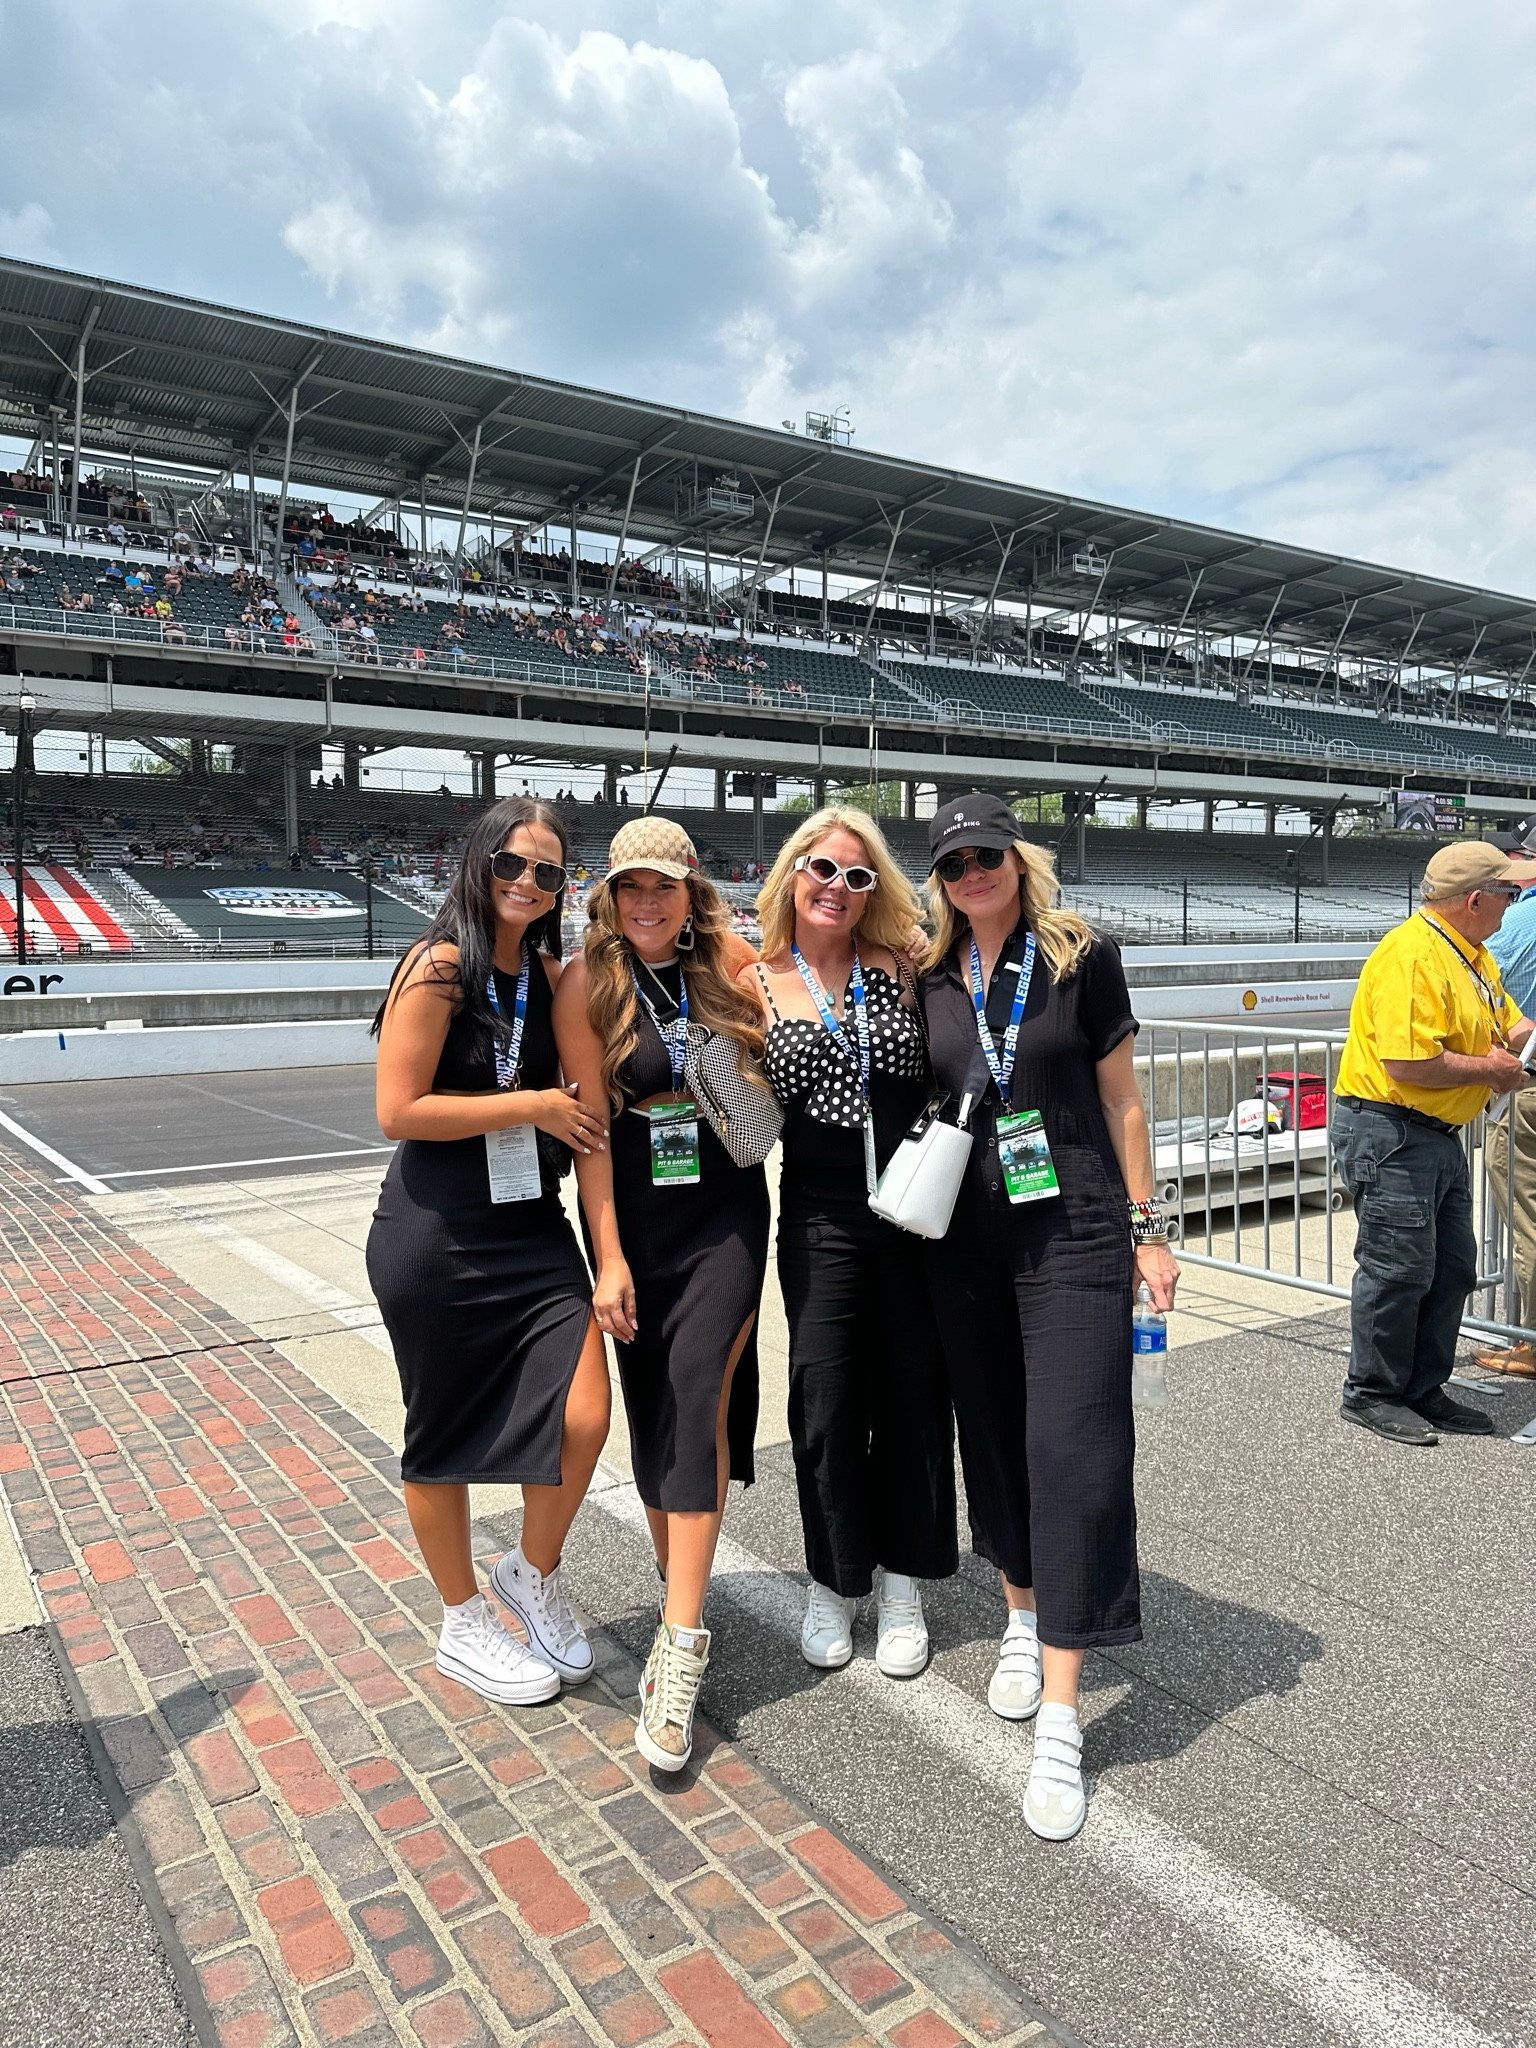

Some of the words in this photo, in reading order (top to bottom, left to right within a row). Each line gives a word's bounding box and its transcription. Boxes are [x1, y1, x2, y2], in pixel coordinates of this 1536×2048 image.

[943, 823, 961, 836] ANINE
[792, 952, 807, 974] DAY
[1015, 948, 1036, 1005] LEGENDS
[1026, 931, 1037, 948] DA
[802, 973, 831, 1017] LEGENDS
[1261, 996, 1274, 1004] Shell
[1275, 993, 1305, 1002] Renewable
[509, 1017, 524, 1059] GRAND
[676, 1017, 687, 1041] 500
[855, 1004, 870, 1047] GRAND
[1005, 1024, 1019, 1051] 500
[832, 1029, 853, 1056] 500
[976, 1009, 994, 1050] GRAND
[986, 1051, 1001, 1083] PRIX
[674, 1042, 686, 1074] INDY
[860, 1050, 870, 1080] PRIX
[1001, 1056, 1015, 1084] INDY
[500, 1058, 518, 1088] PRIX
[672, 1158, 694, 1166] GARAGE
[1025, 1169, 1049, 1179] GARAGE
